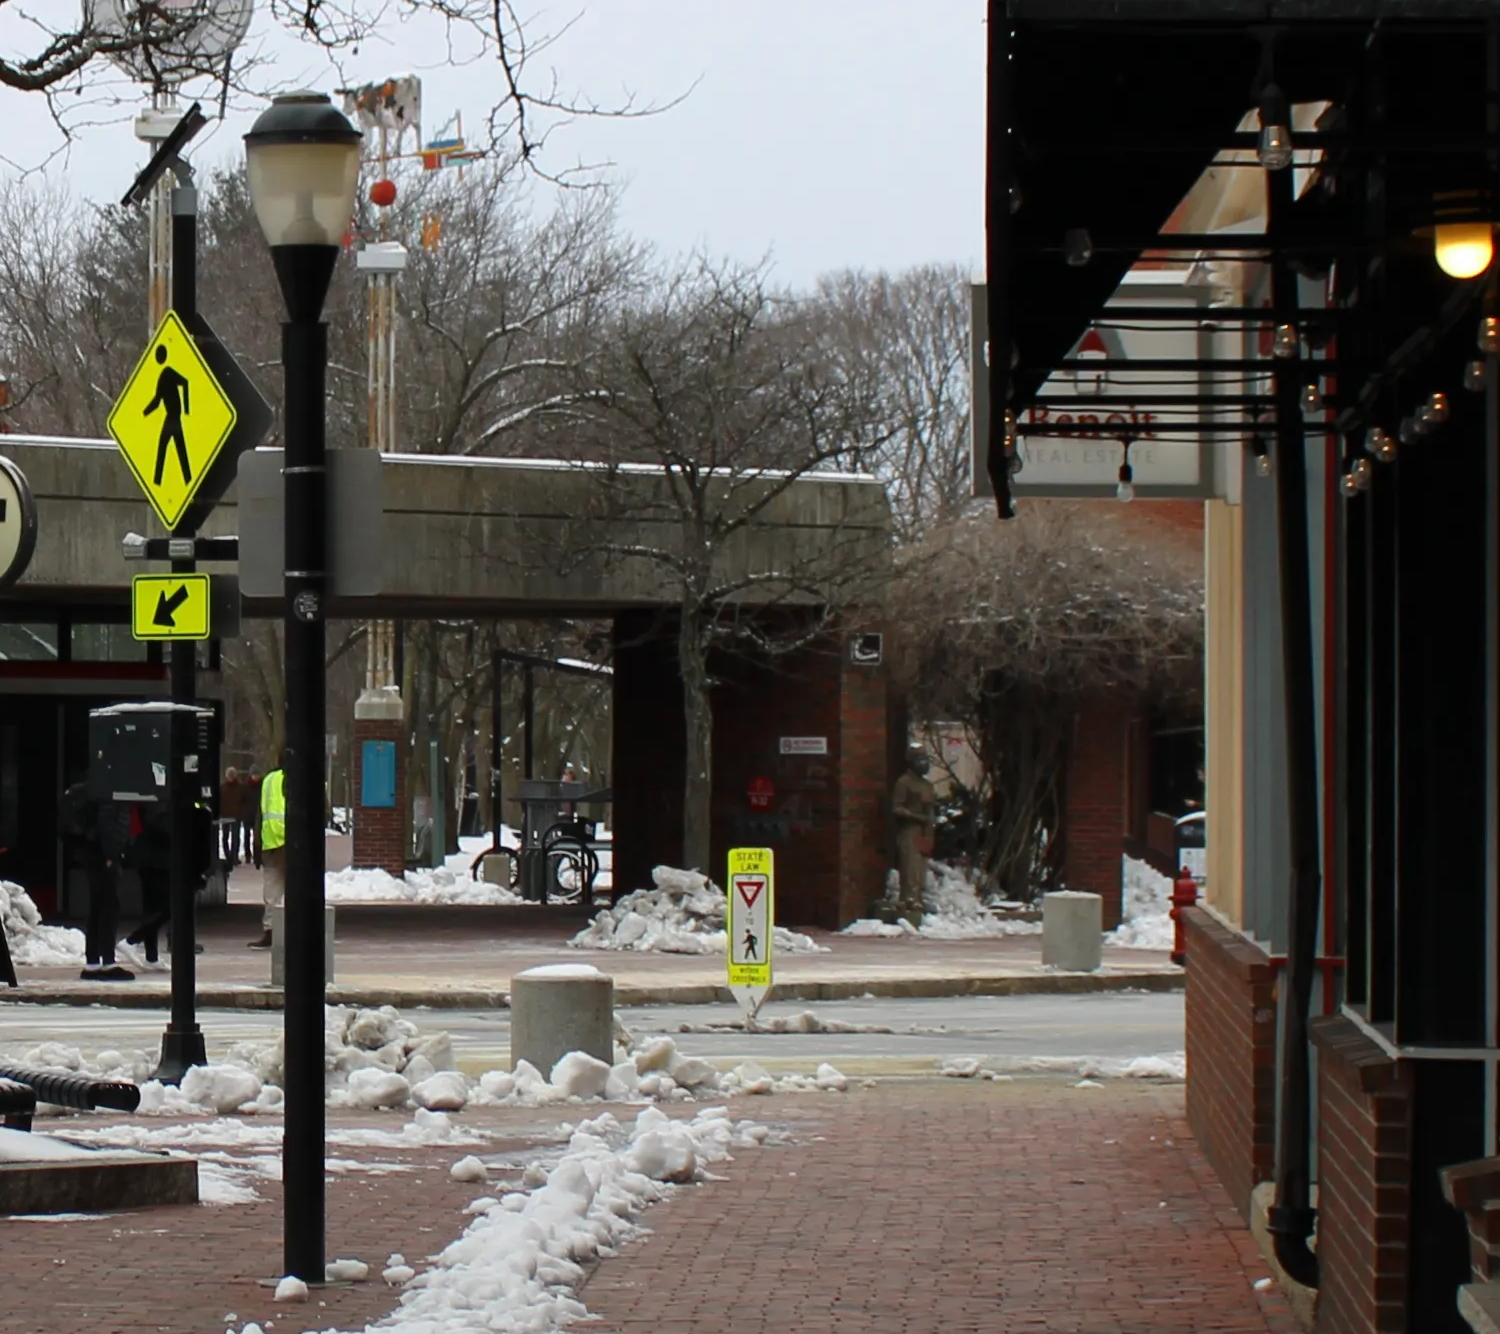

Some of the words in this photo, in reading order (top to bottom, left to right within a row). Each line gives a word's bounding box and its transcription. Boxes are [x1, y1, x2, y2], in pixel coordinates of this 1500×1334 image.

[1083, 450, 1157, 464] ESTTE
[736, 852, 764, 862] STATE
[740, 863, 760, 872] LAW
[745, 917, 755, 926] TO
